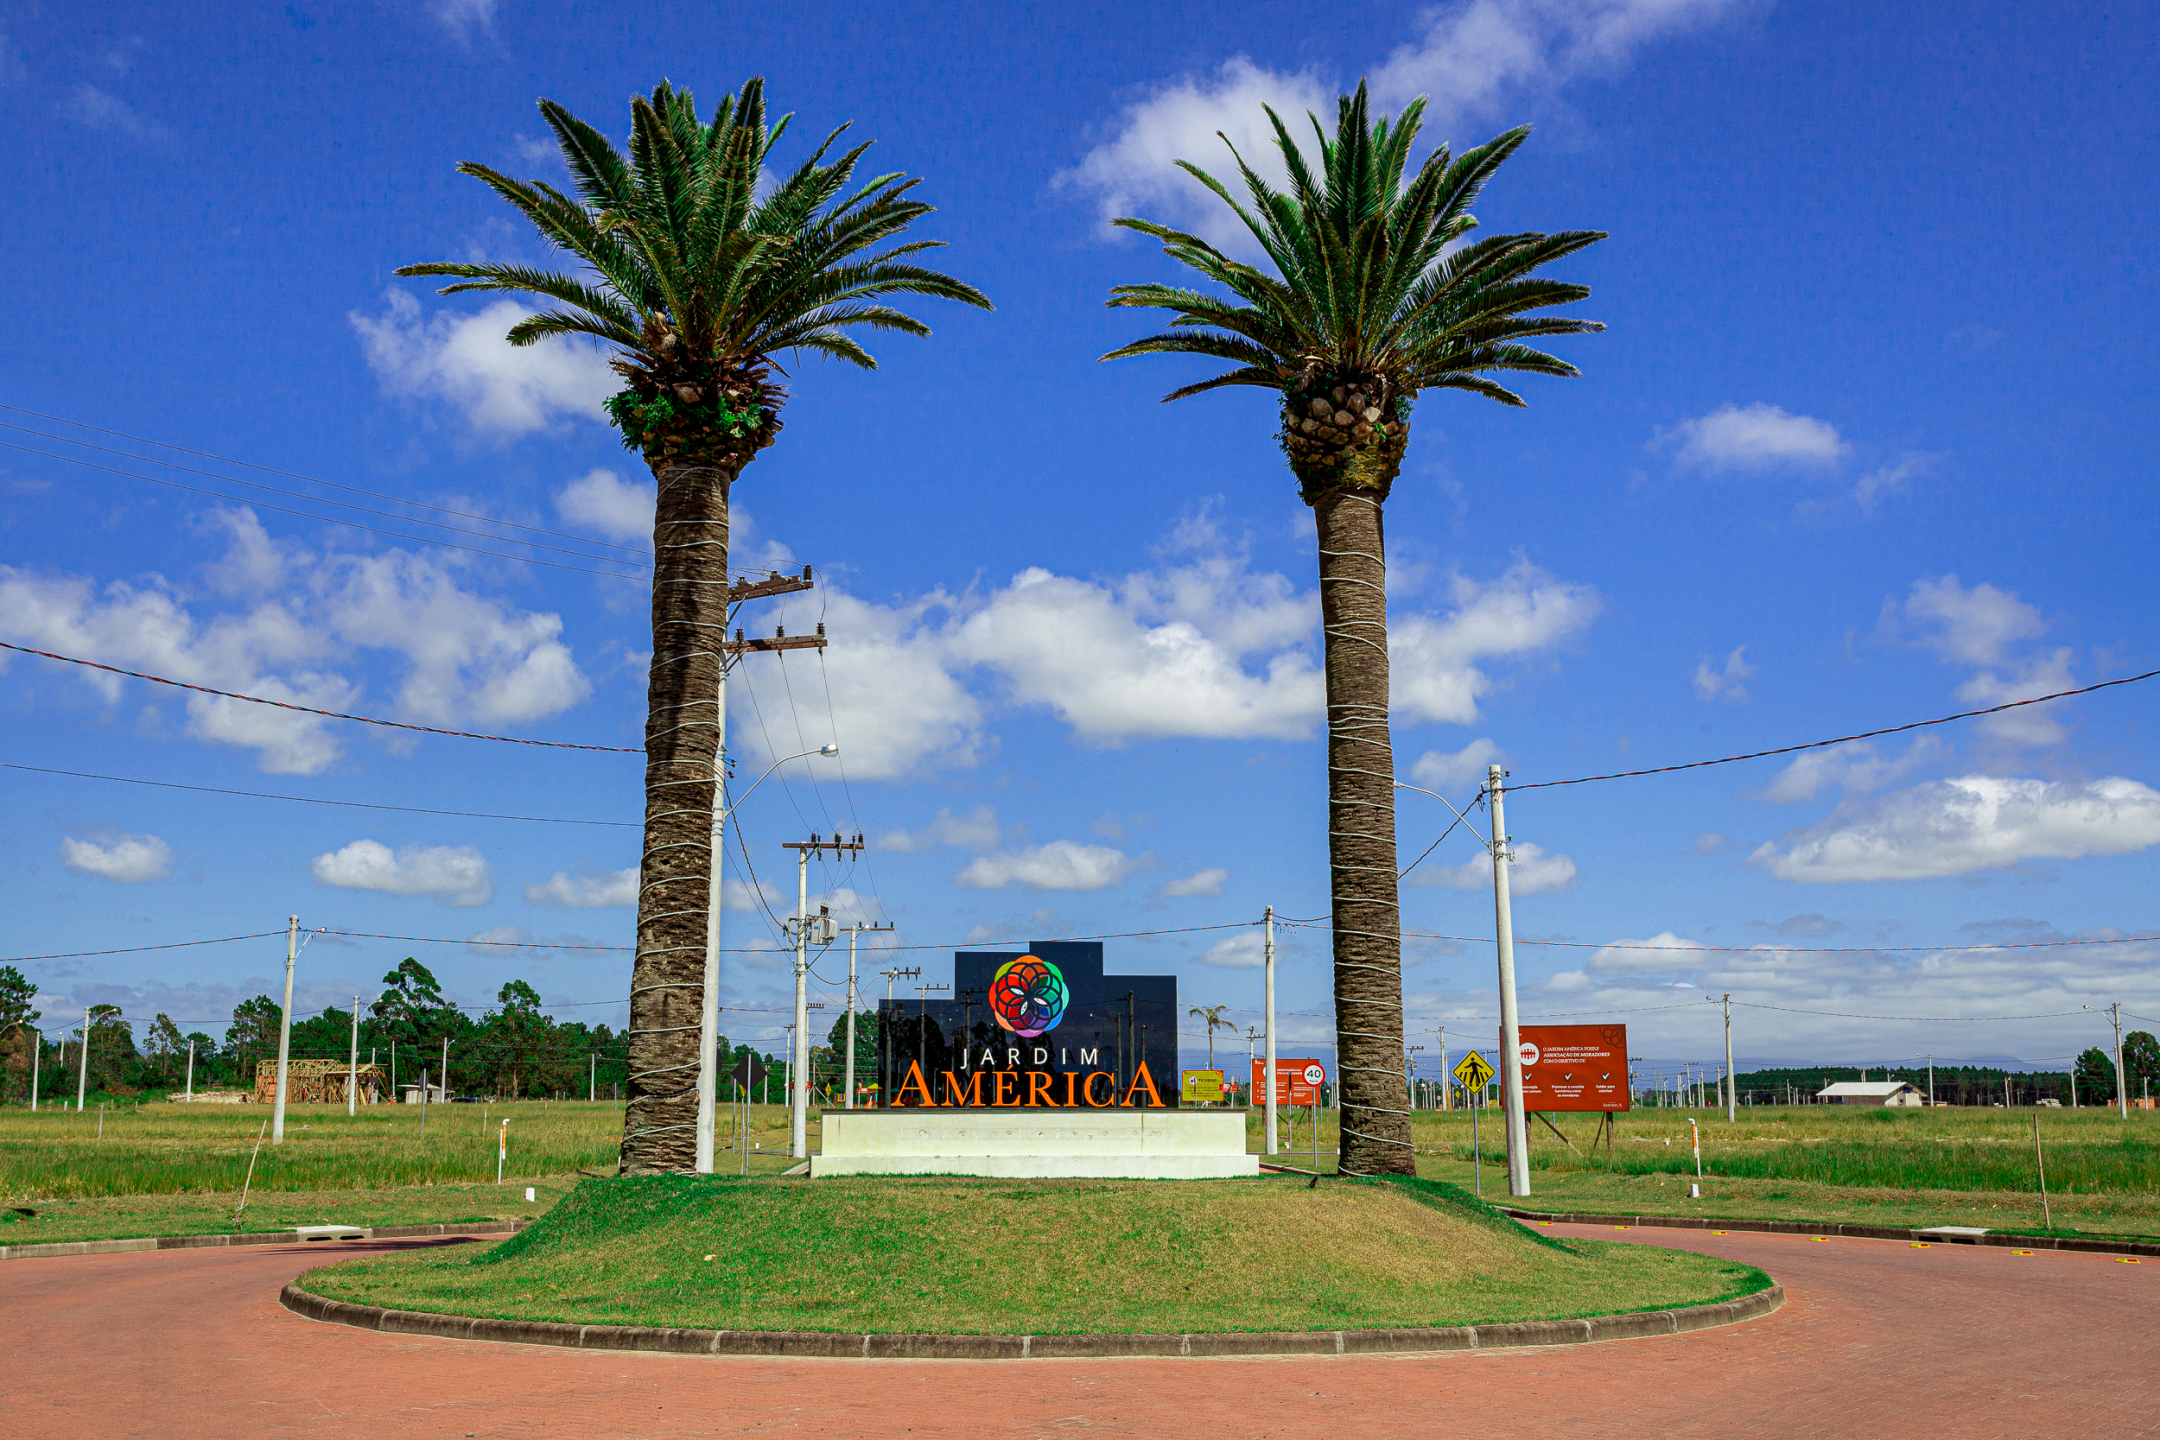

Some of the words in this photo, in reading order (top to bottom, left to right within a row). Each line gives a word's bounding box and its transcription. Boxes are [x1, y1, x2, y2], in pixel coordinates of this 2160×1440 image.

[960, 1048, 1099, 1069] JARDIM
[890, 1059, 1167, 1107] AMÉRICA
[1307, 1070, 1321, 1078] 40
